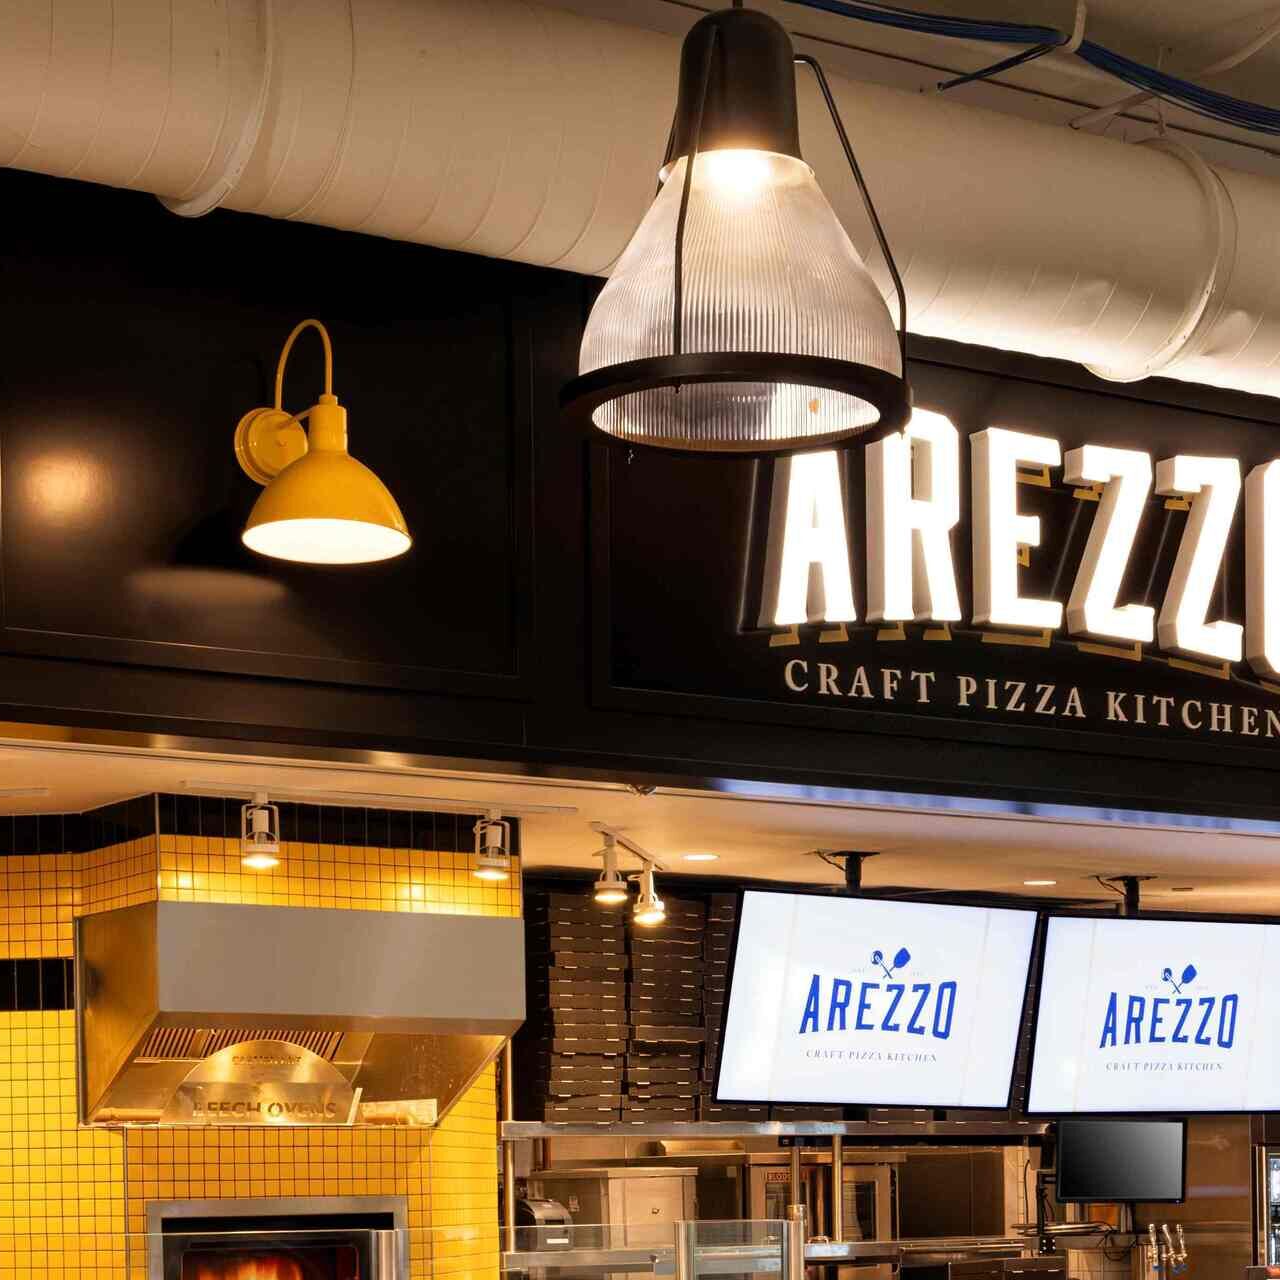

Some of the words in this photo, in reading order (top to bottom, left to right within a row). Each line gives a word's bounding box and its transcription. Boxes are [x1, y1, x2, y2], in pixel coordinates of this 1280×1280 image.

[784, 659, 935, 703] CRAFT
[957, 676, 1087, 719] PIZZA
[798, 973, 958, 1041] AREZZO
[1099, 991, 1239, 1050] AREZZO
[806, 1049, 846, 1059] CRAFT
[848, 1050, 883, 1061] PIZZA
[887, 1052, 937, 1063] KITCHEN
[1106, 1062, 1139, 1071] CRAFT
[1143, 1062, 1173, 1072] PIZZA
[1177, 1062, 1223, 1072] KITCHEN
